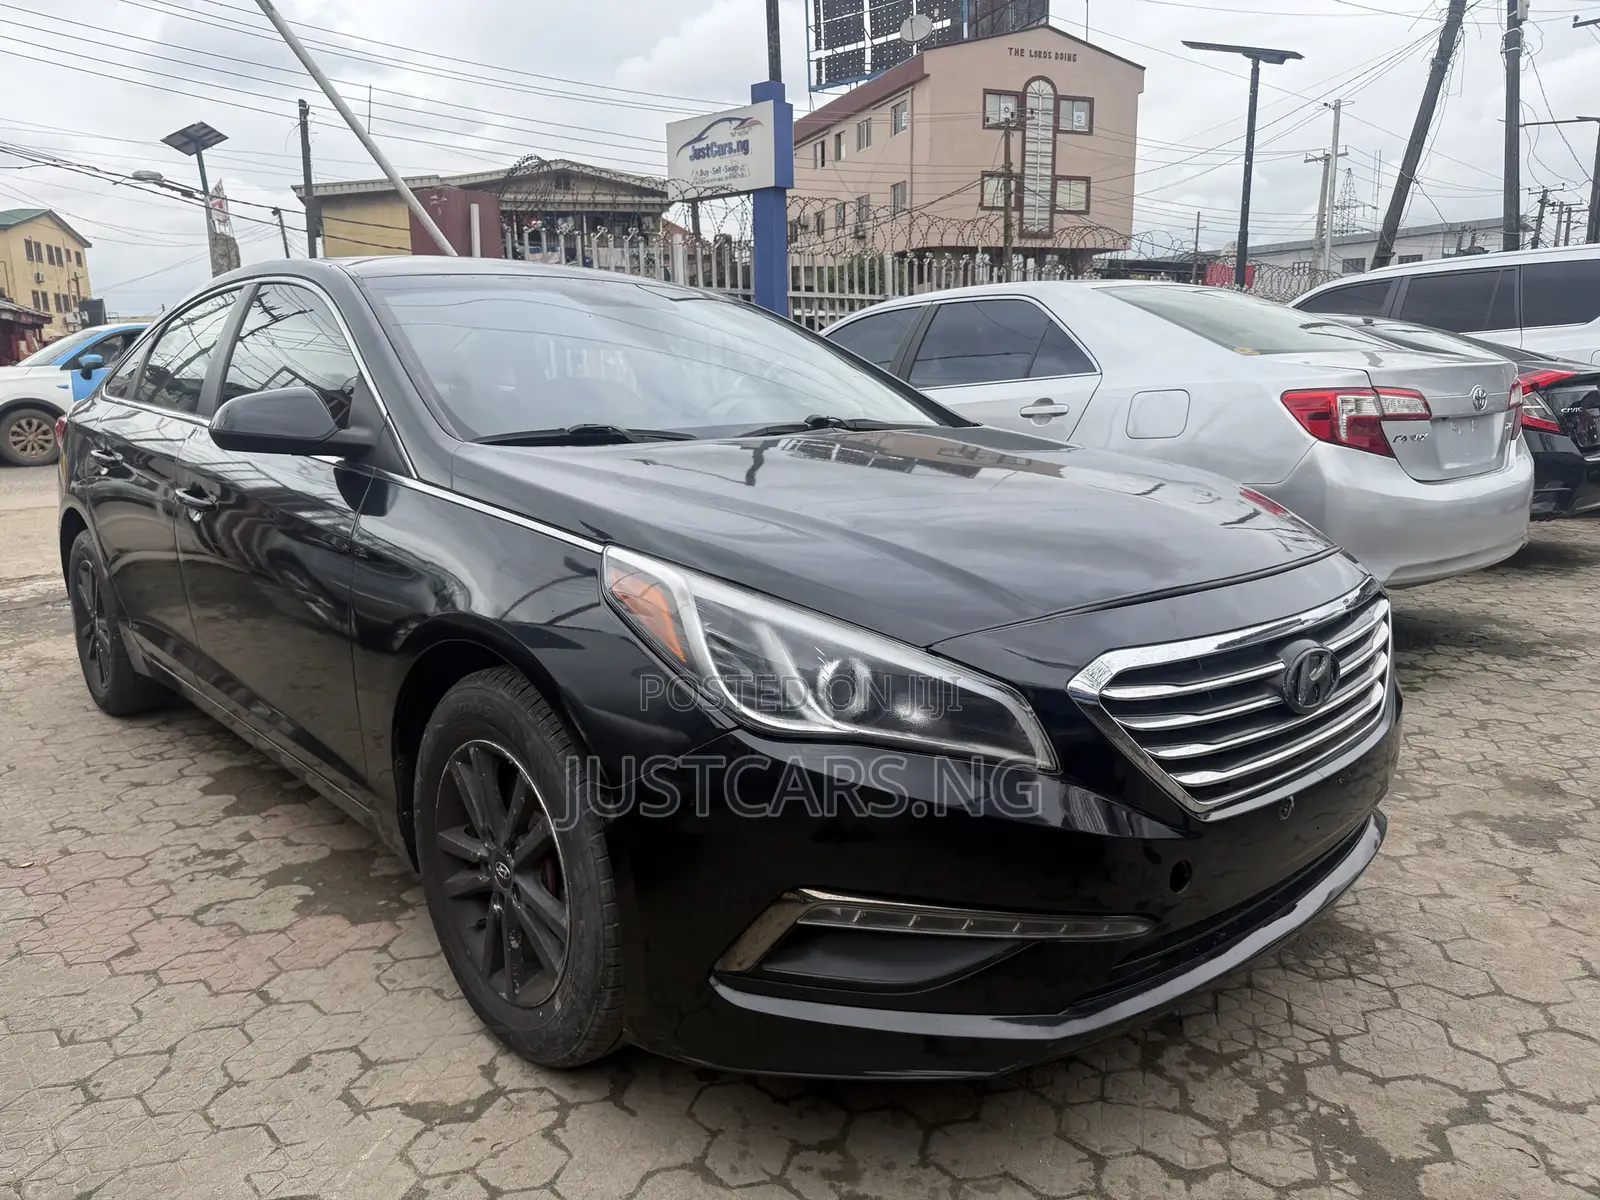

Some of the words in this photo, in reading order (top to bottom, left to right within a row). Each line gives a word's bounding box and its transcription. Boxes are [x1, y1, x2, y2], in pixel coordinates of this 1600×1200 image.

[1008, 47, 1025, 57] THE
[1054, 51, 1077, 63] DOING
[689, 139, 750, 161] JustCars.ng
[700, 168, 710, 178] Buy
[1560, 406, 1584, 414] CIVIC
